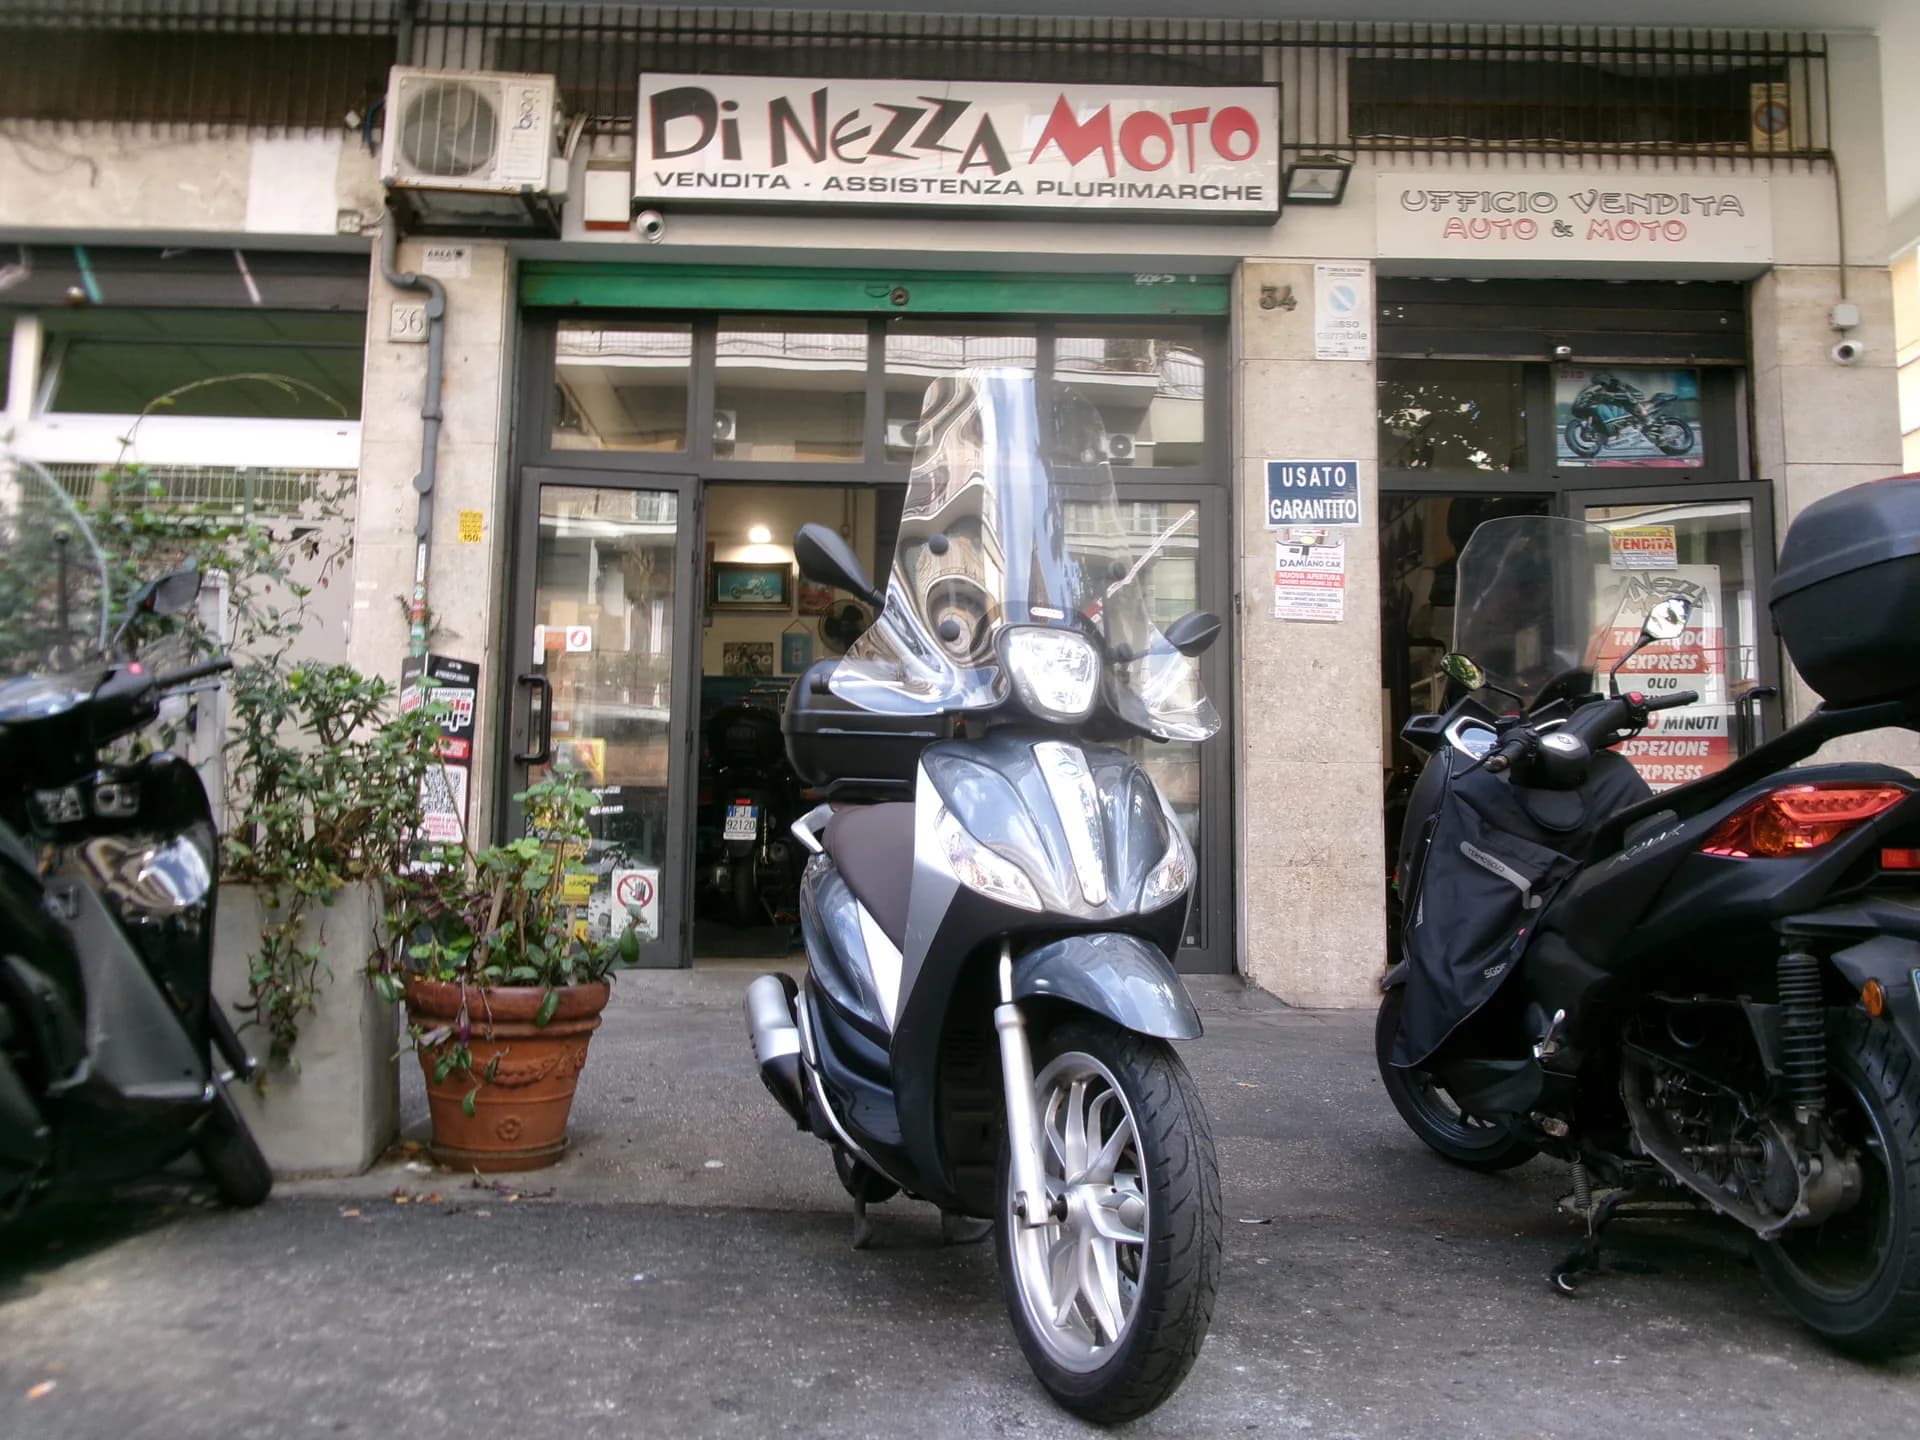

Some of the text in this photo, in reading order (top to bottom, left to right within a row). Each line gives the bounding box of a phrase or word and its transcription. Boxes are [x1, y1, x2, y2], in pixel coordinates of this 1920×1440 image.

[1028, 92, 1260, 178] MOTO
[655, 171, 790, 189] VENDITA
[823, 176, 1024, 195] ASSISTENZA
[1036, 180, 1263, 201] PLURIMARCHE
[1400, 189, 1744, 217] UFFICIO VENDITA
[1443, 216, 1687, 242] AUTO & MOTO
[394, 308, 424, 334] 36
[1282, 466, 1346, 488] USATO
[1270, 499, 1357, 520] GARANTITO
[1280, 558, 1324, 567] DAMIANO
[1626, 654, 1698, 670] EXPRESS
[1621, 740, 1710, 757] ISPEZIONE
